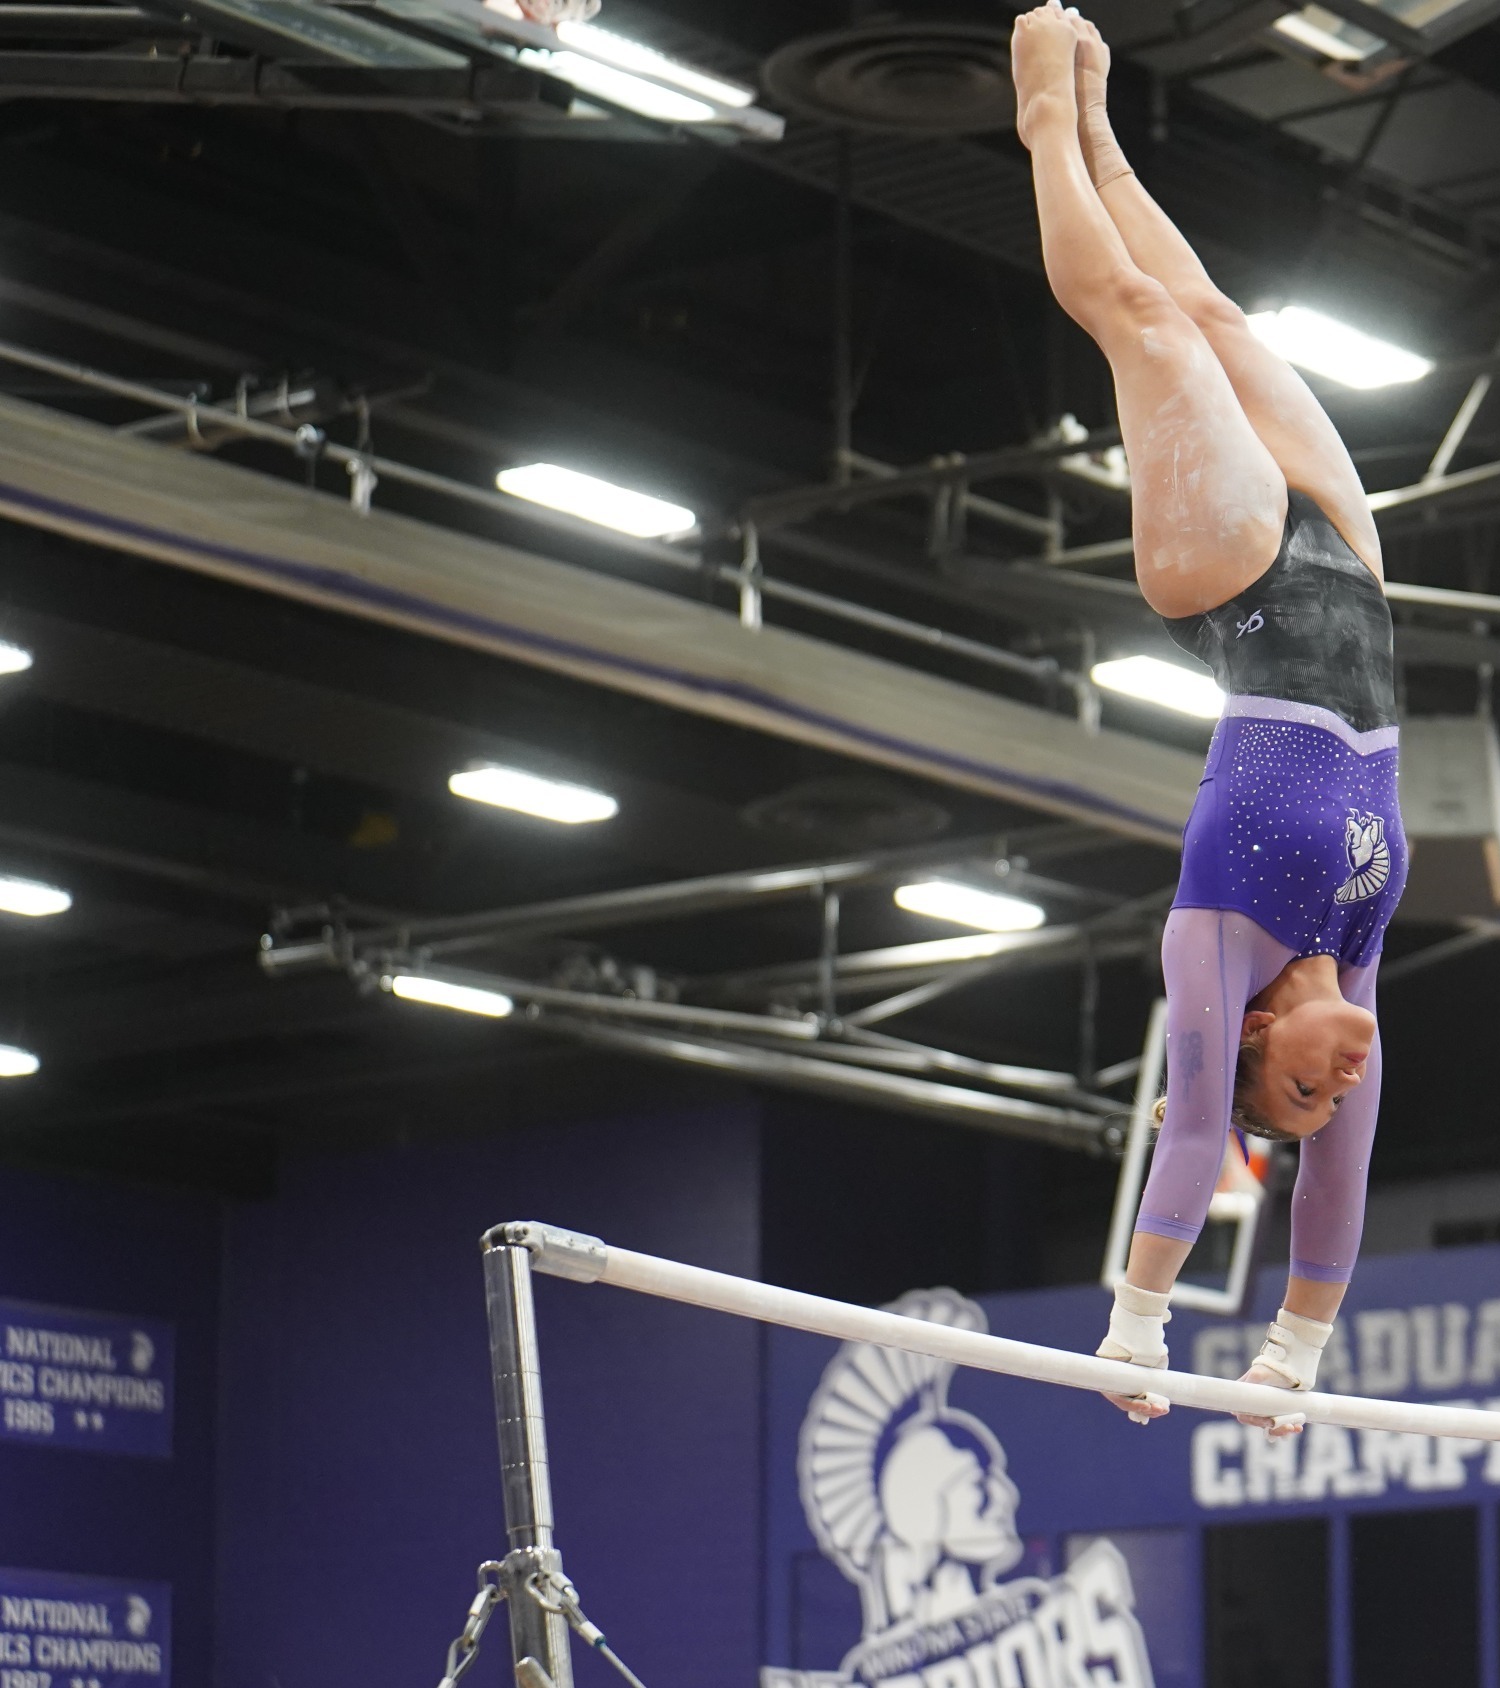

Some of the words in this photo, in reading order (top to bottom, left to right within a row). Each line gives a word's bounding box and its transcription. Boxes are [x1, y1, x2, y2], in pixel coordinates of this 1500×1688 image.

[6, 1325, 117, 1372] NATIONAL
[38, 1364, 165, 1415] CHAMPIONS
[2, 1596, 113, 1636] NATIONAL
[34, 1633, 161, 1676] CHAMPIONS
